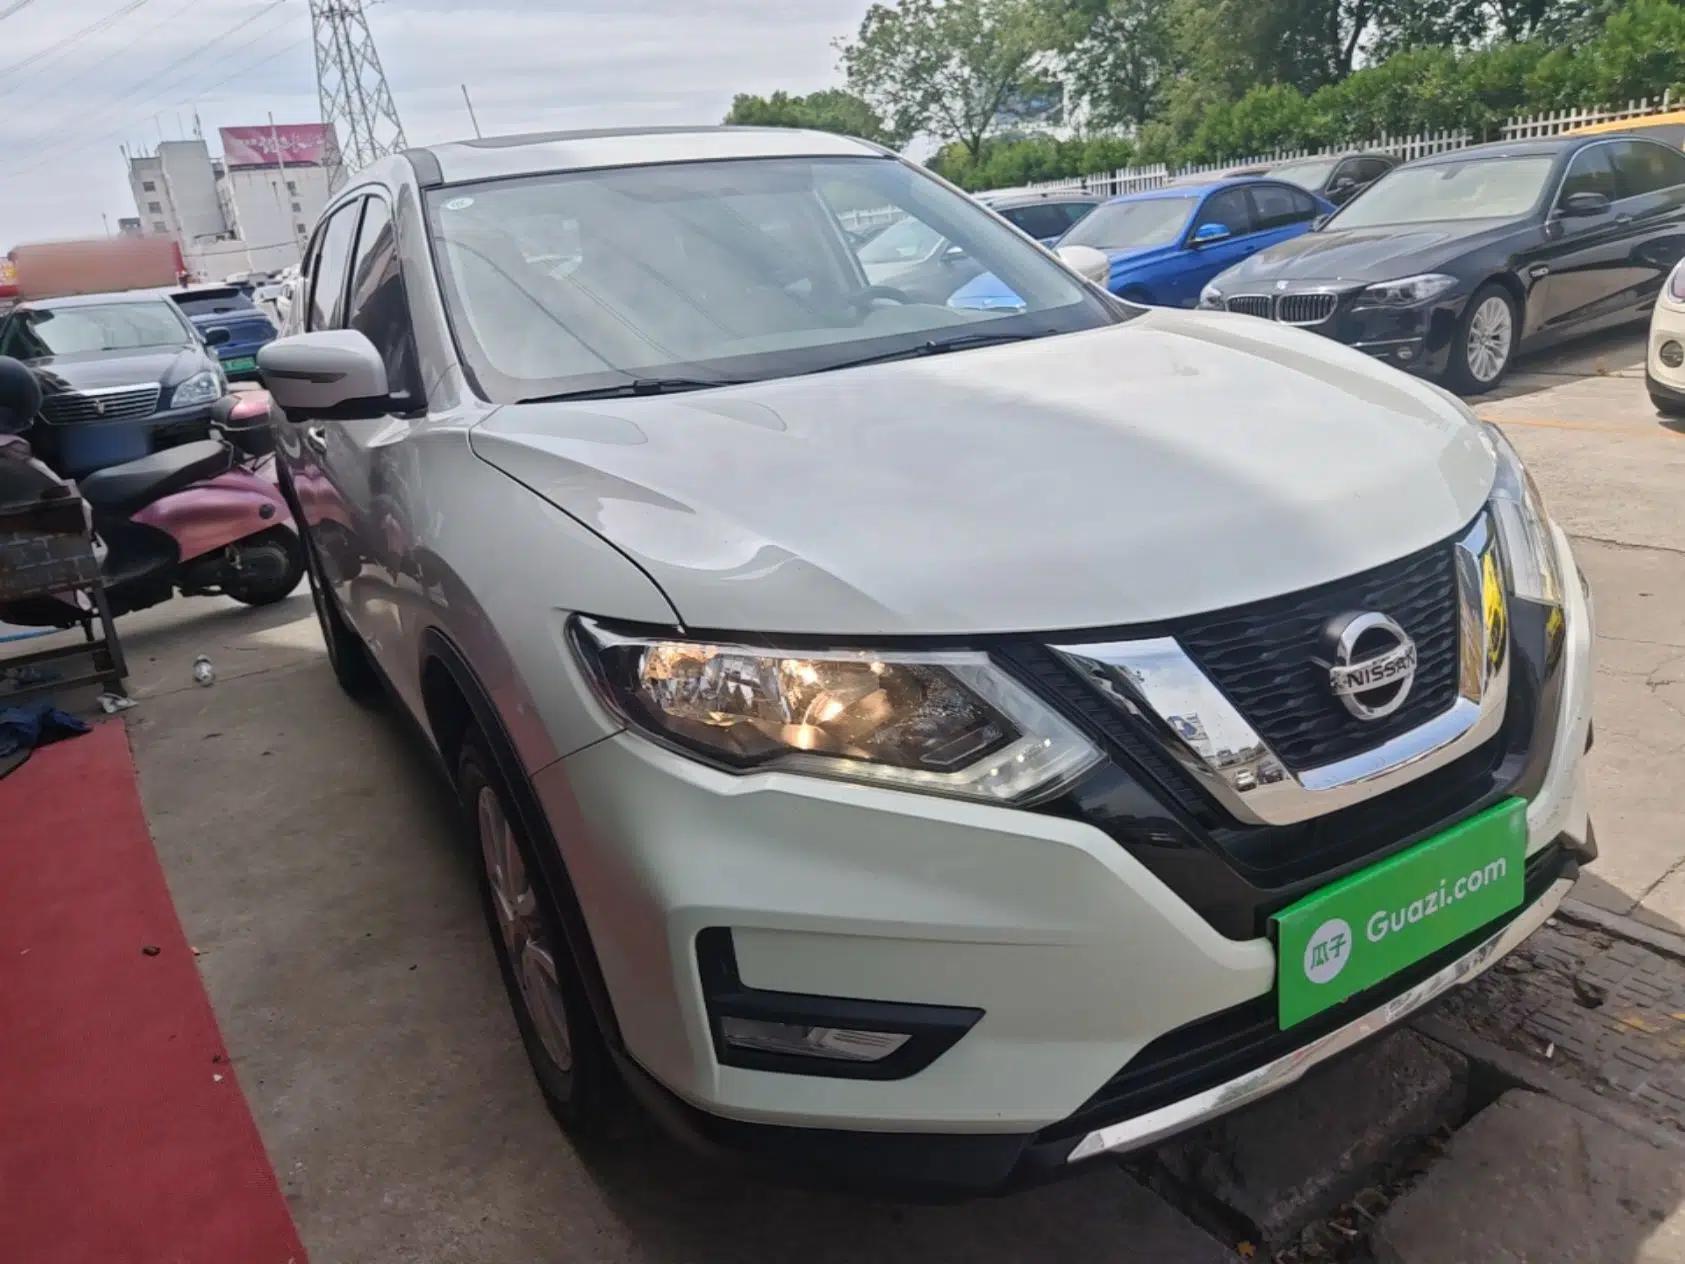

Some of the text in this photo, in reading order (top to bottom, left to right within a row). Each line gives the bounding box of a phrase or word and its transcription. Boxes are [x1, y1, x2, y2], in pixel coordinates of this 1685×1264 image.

[1346, 646, 1415, 688] NISSAN
[1366, 857, 1507, 943] Guazi.com
[1310, 932, 1348, 970] 瓜子
